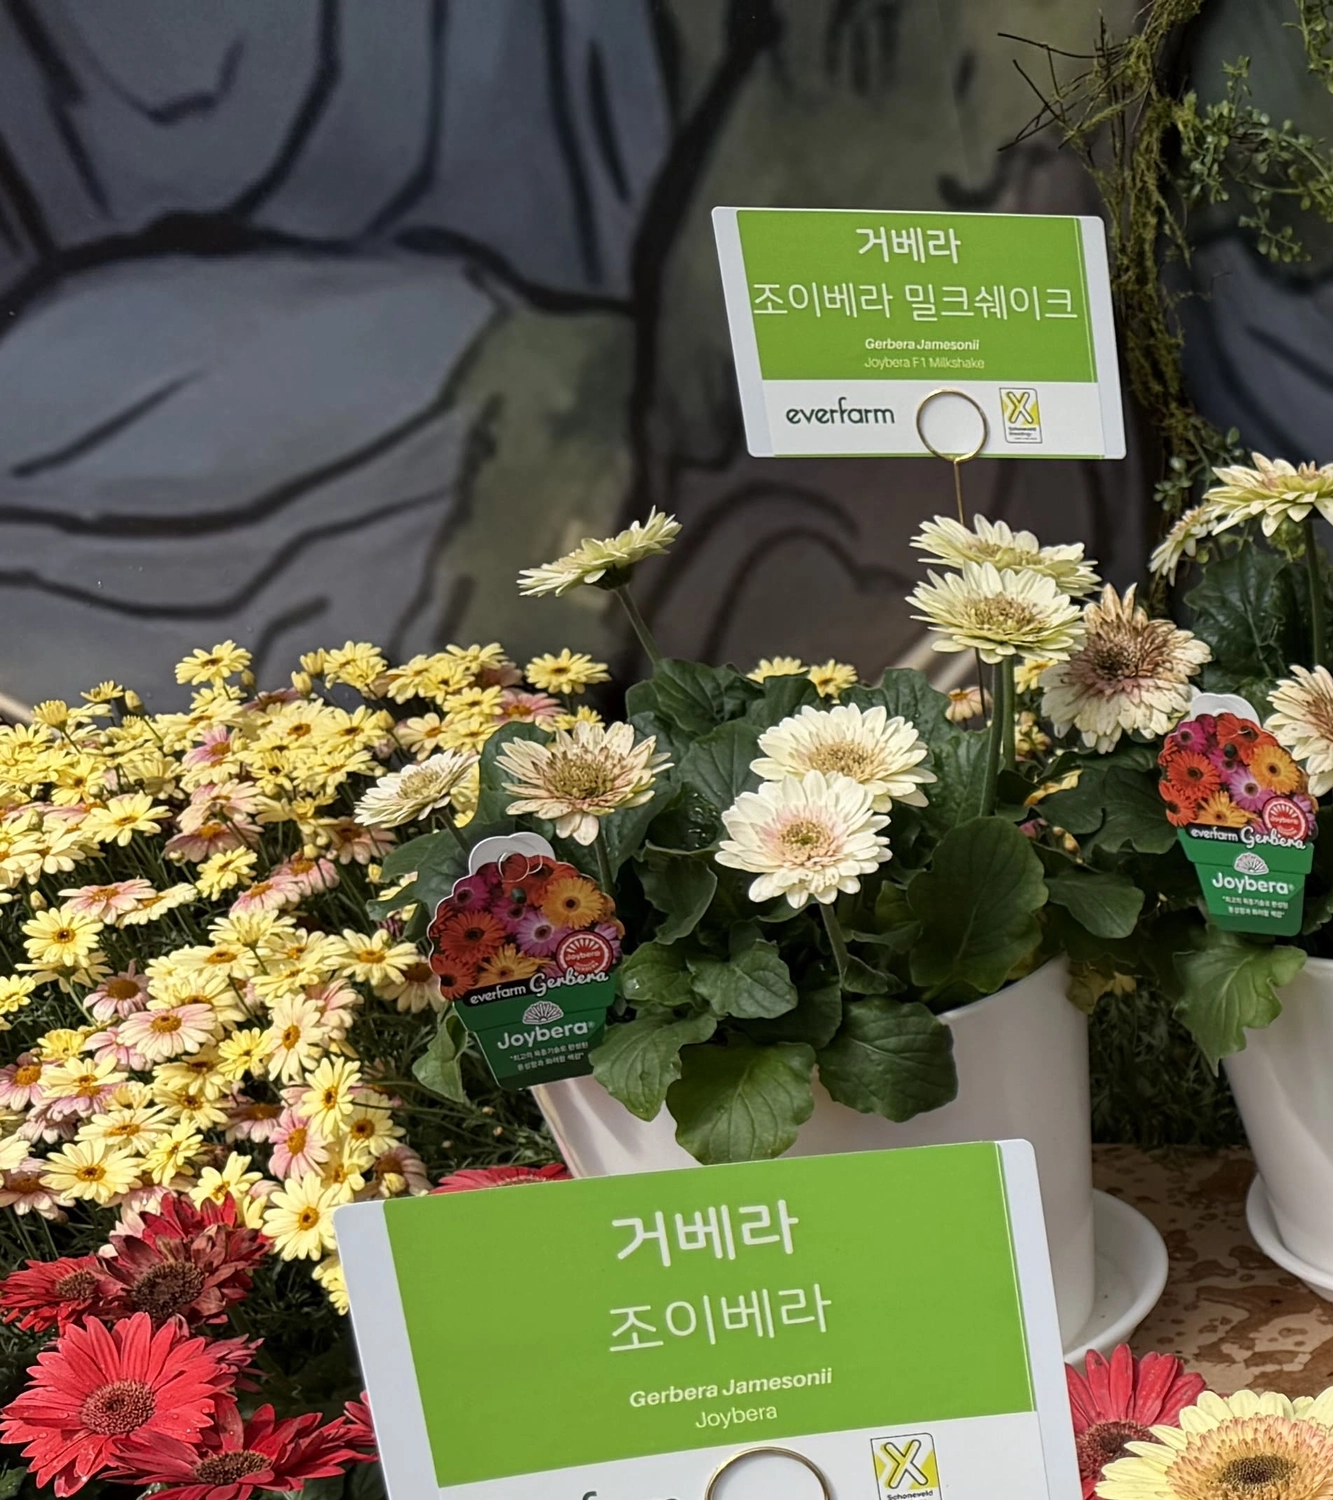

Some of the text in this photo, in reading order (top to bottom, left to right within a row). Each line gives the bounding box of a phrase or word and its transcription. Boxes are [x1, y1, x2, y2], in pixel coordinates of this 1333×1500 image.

[856, 227, 961, 264] 거베라
[753, 282, 1078, 321] 조이베라 밀크쉐이크
[865, 338, 980, 351] Gerbera Jamesonii
[864, 357, 984, 369] Joybera F1 Milkshake
[786, 396, 895, 424] everfarm
[1191, 827, 1238, 842] everfarm
[1240, 826, 1306, 850] Gerbera
[1212, 873, 1290, 895] Joybera
[470, 967, 609, 1004] everfarm Gerbera
[612, 1199, 799, 1268] 거베라
[608, 1282, 832, 1354] 조이베라
[629, 1368, 833, 1410] Gerbera Jamesonii
[695, 1403, 778, 1430] Joybera
